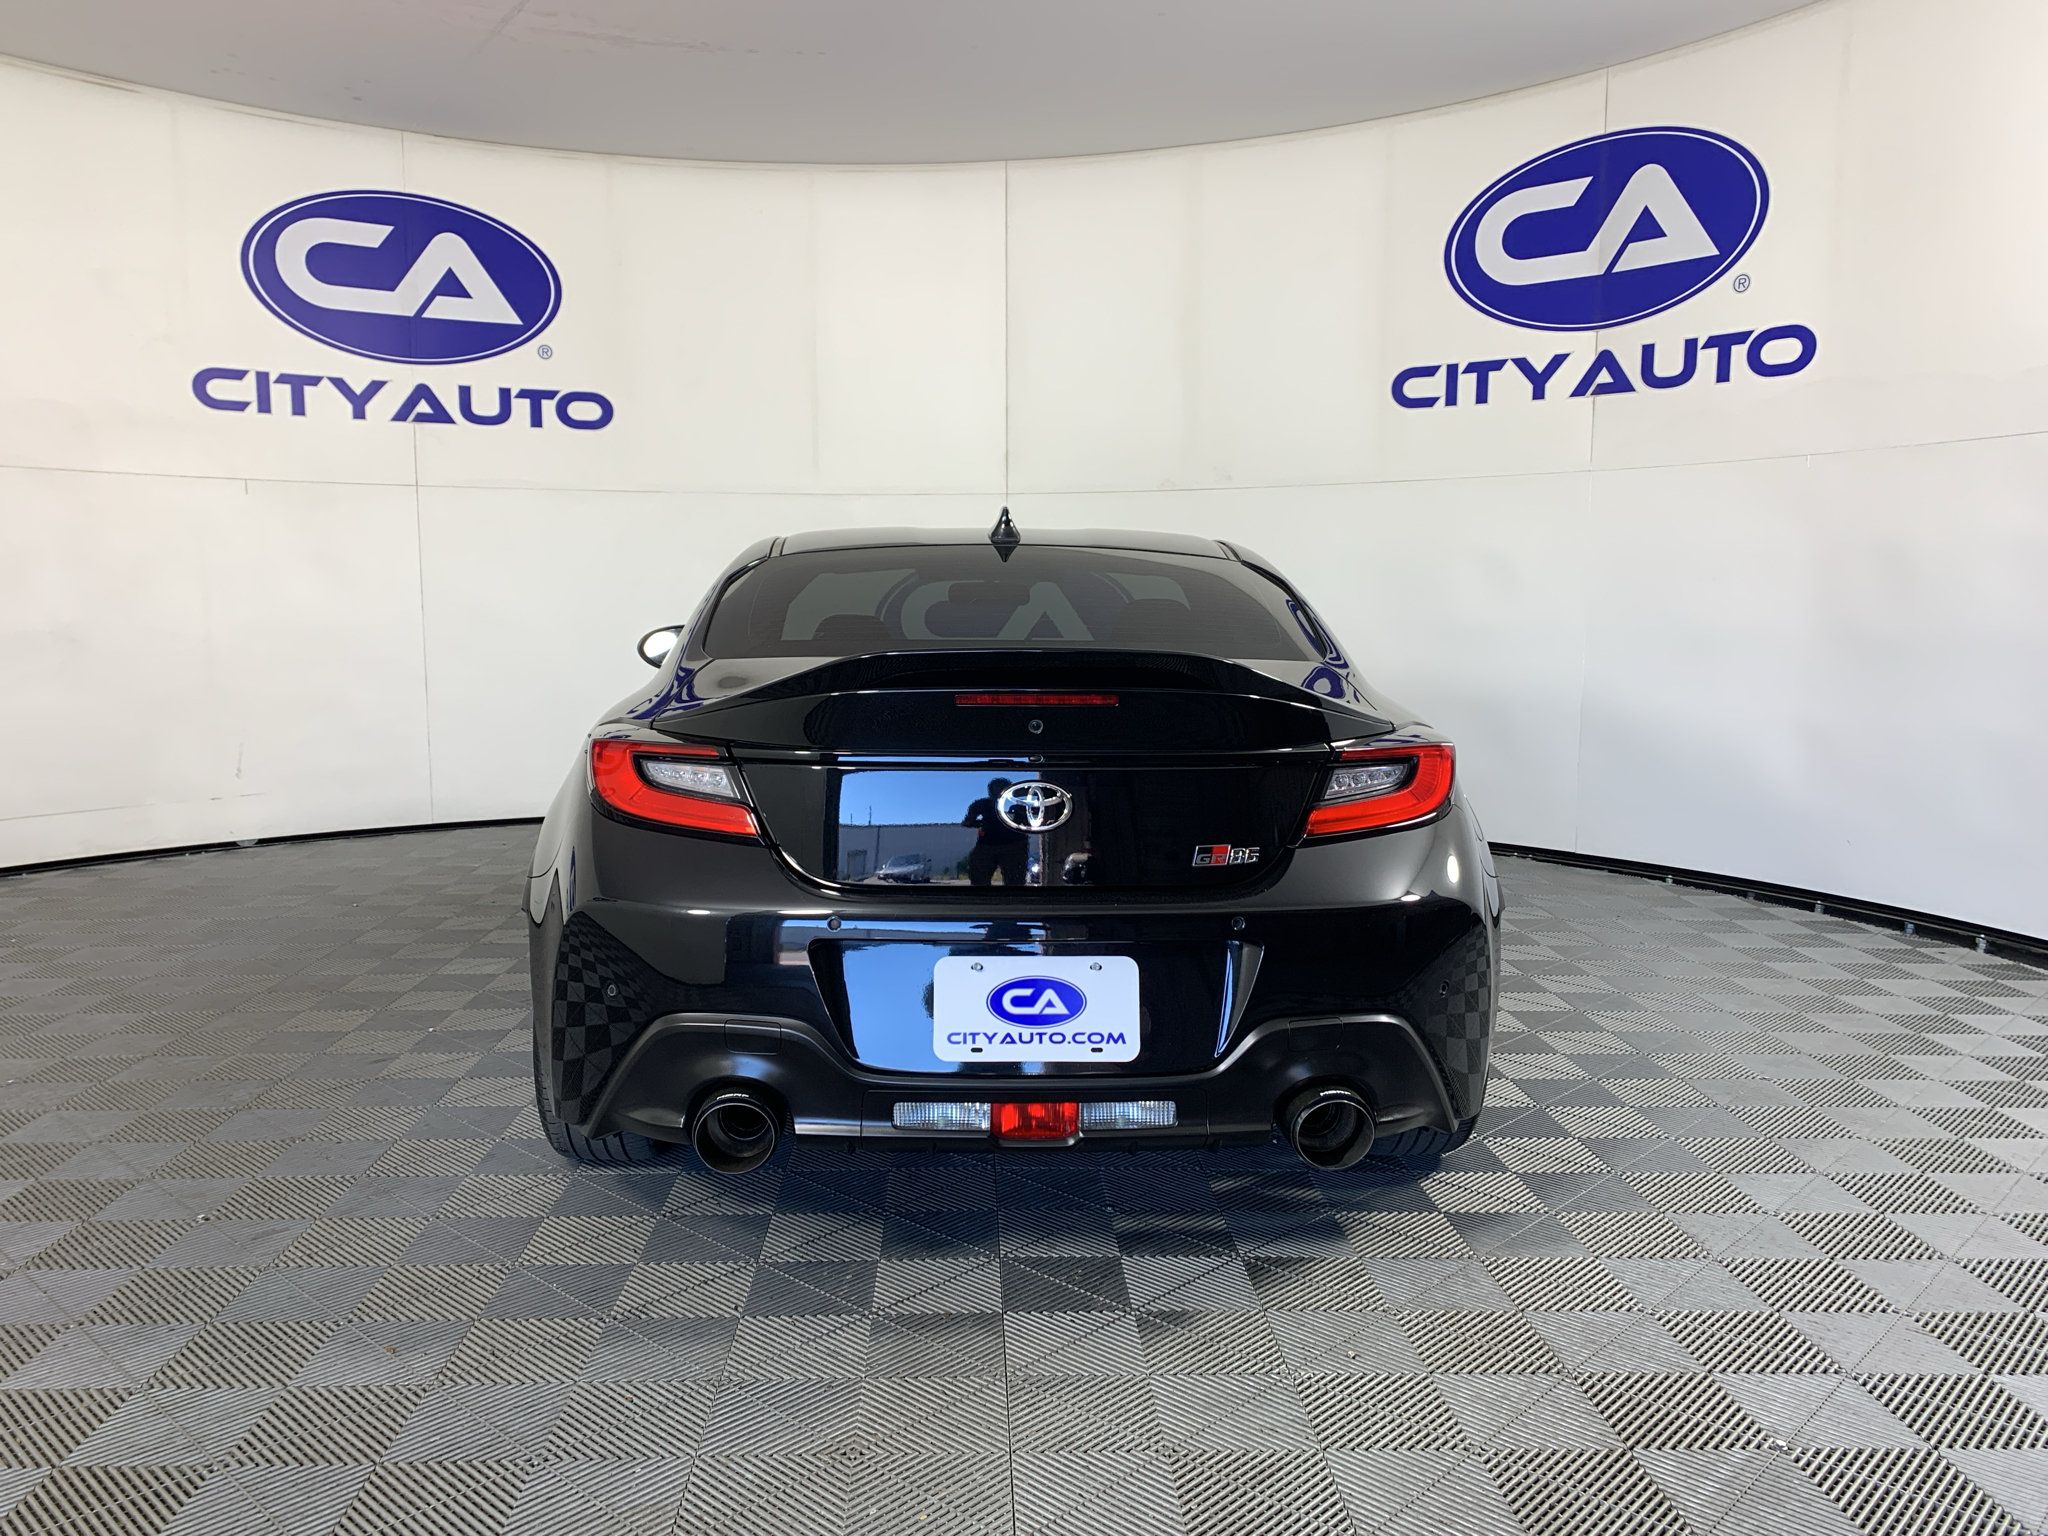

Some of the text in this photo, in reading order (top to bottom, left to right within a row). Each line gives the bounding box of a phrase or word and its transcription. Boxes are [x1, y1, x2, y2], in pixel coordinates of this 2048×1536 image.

[1475, 163, 1721, 286] CA
[275, 217, 524, 326] CA
[1001, 988, 1071, 1015] CA
[946, 1031, 1127, 1045] CITYAUTO.COM
